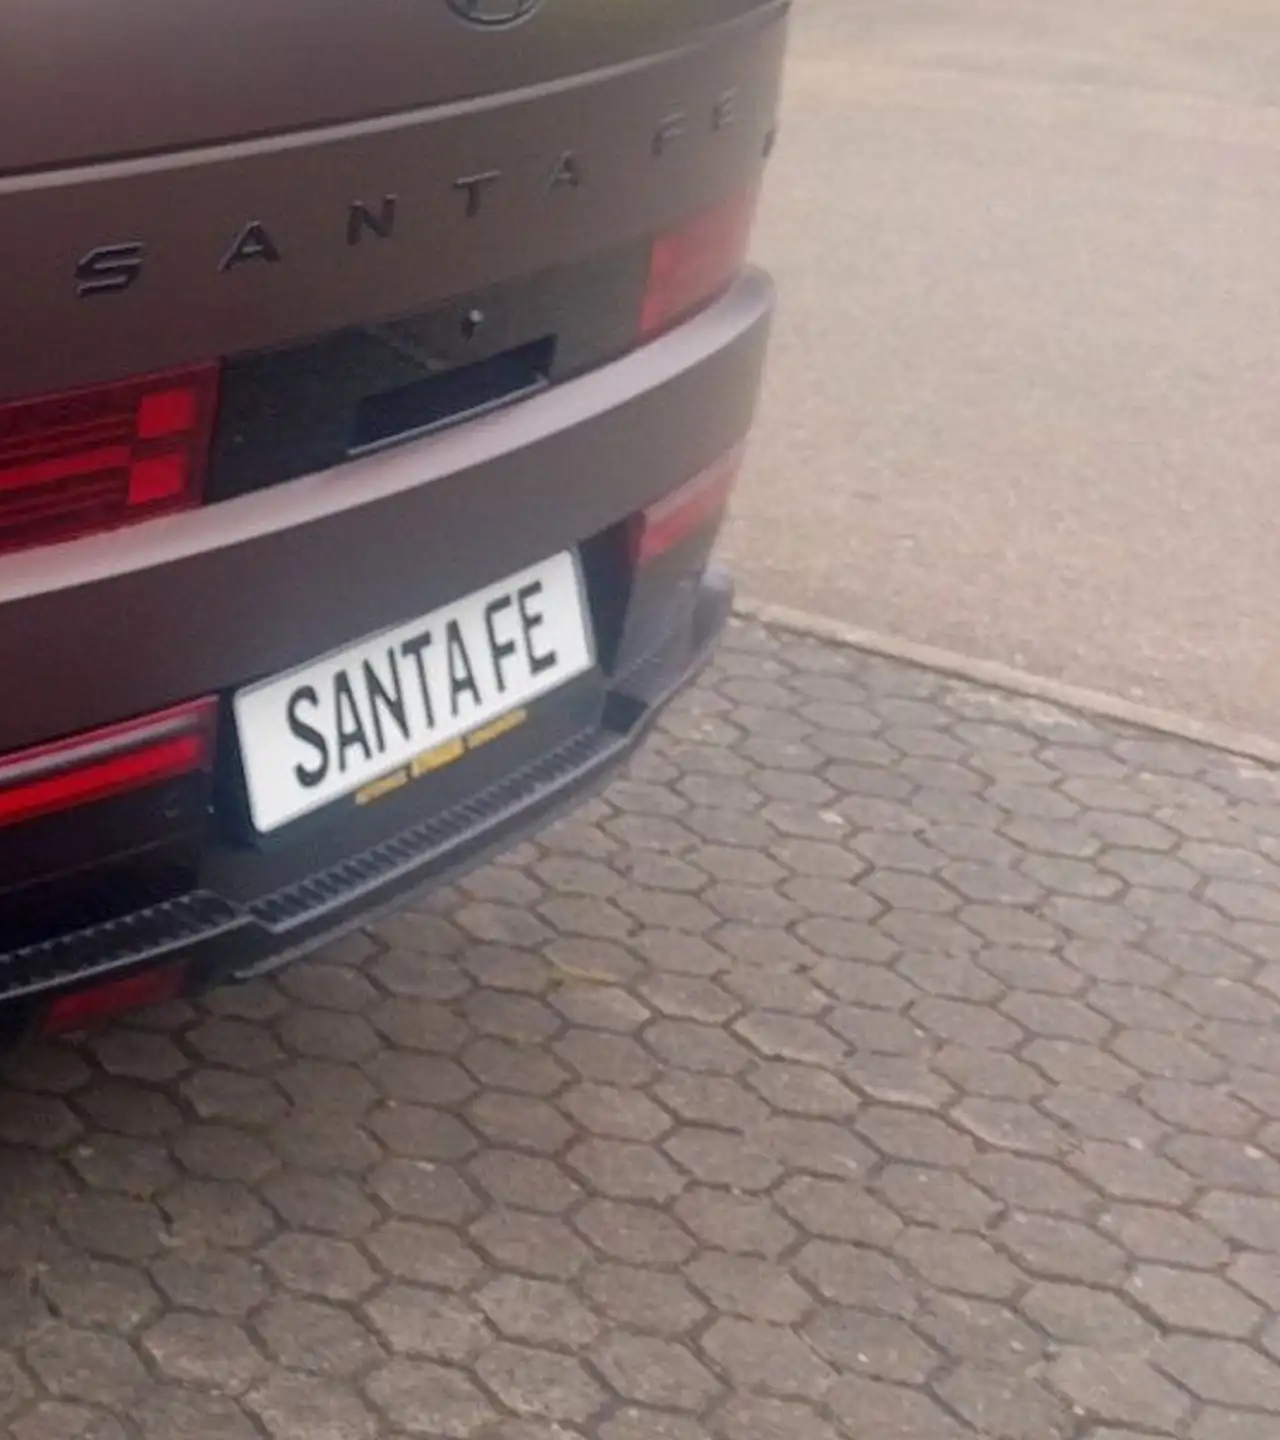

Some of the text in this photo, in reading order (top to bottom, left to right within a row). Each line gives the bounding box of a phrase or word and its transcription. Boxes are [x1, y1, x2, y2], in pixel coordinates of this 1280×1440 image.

[74, 86, 737, 297] SANTA FE
[286, 619, 482, 788] SANTA
[484, 580, 557, 694] FE
